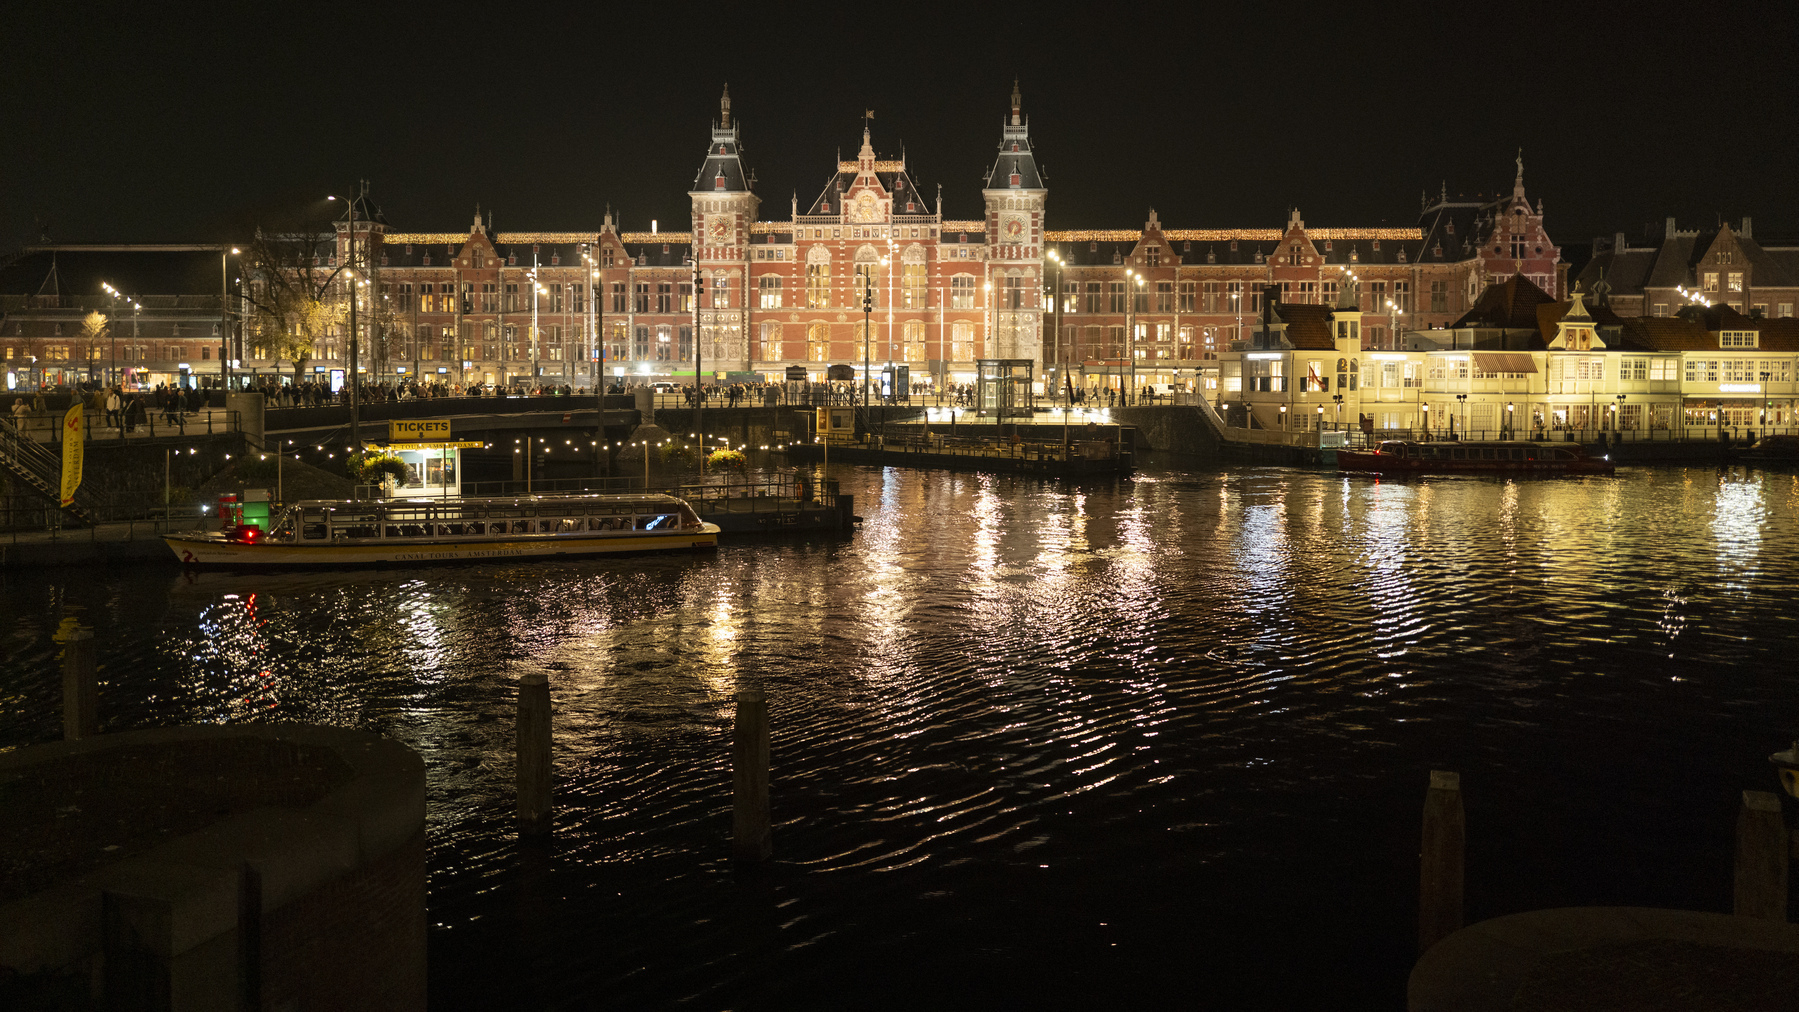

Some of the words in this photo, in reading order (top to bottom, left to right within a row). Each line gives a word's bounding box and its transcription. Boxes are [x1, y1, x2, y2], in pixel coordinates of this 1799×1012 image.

[396, 422, 449, 432] TICKETS
[427, 441, 474, 449] AMSERDAM
[395, 553, 425, 561] CANAL
[430, 551, 459, 559] TOURS
[467, 549, 523, 558] AMSTERDAM
